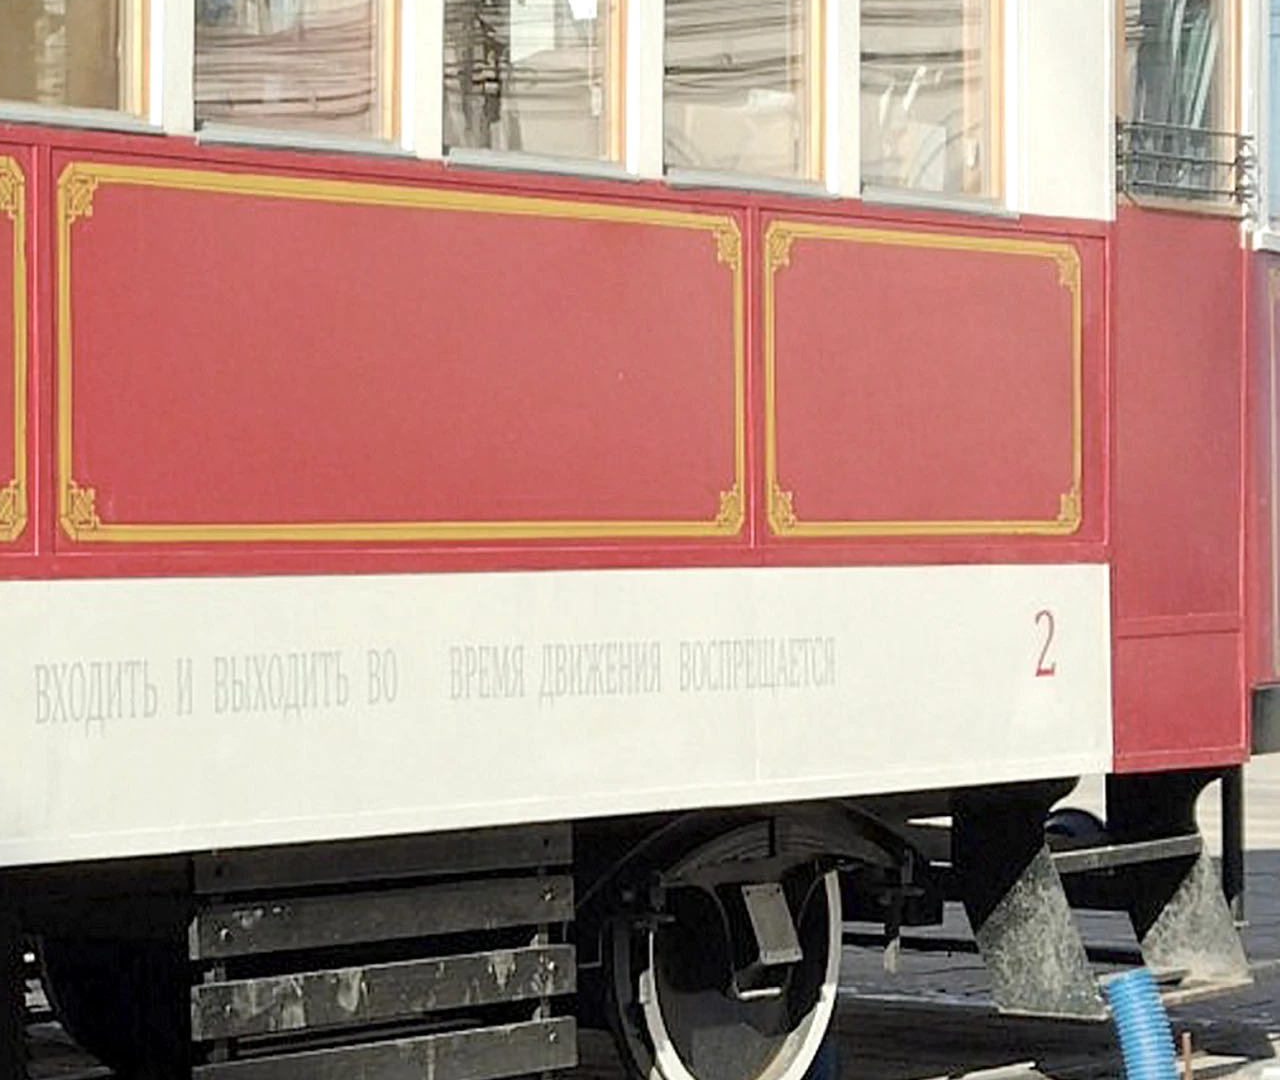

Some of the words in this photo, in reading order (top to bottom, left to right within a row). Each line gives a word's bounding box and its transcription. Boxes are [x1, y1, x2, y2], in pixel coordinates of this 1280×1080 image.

[1035, 609, 1057, 677] 2
[34, 658, 159, 738] ВХОДИТЬ
[175, 657, 194, 717] И
[213, 650, 350, 720] ВЫХОДИТЬ
[366, 648, 399, 706] ВО
[447, 644, 526, 701] ВРЕМЯ
[537, 640, 663, 710] ДВИЖЕНИЯ
[678, 635, 838, 698] ВОСПРЕЩАЕТСЯ
